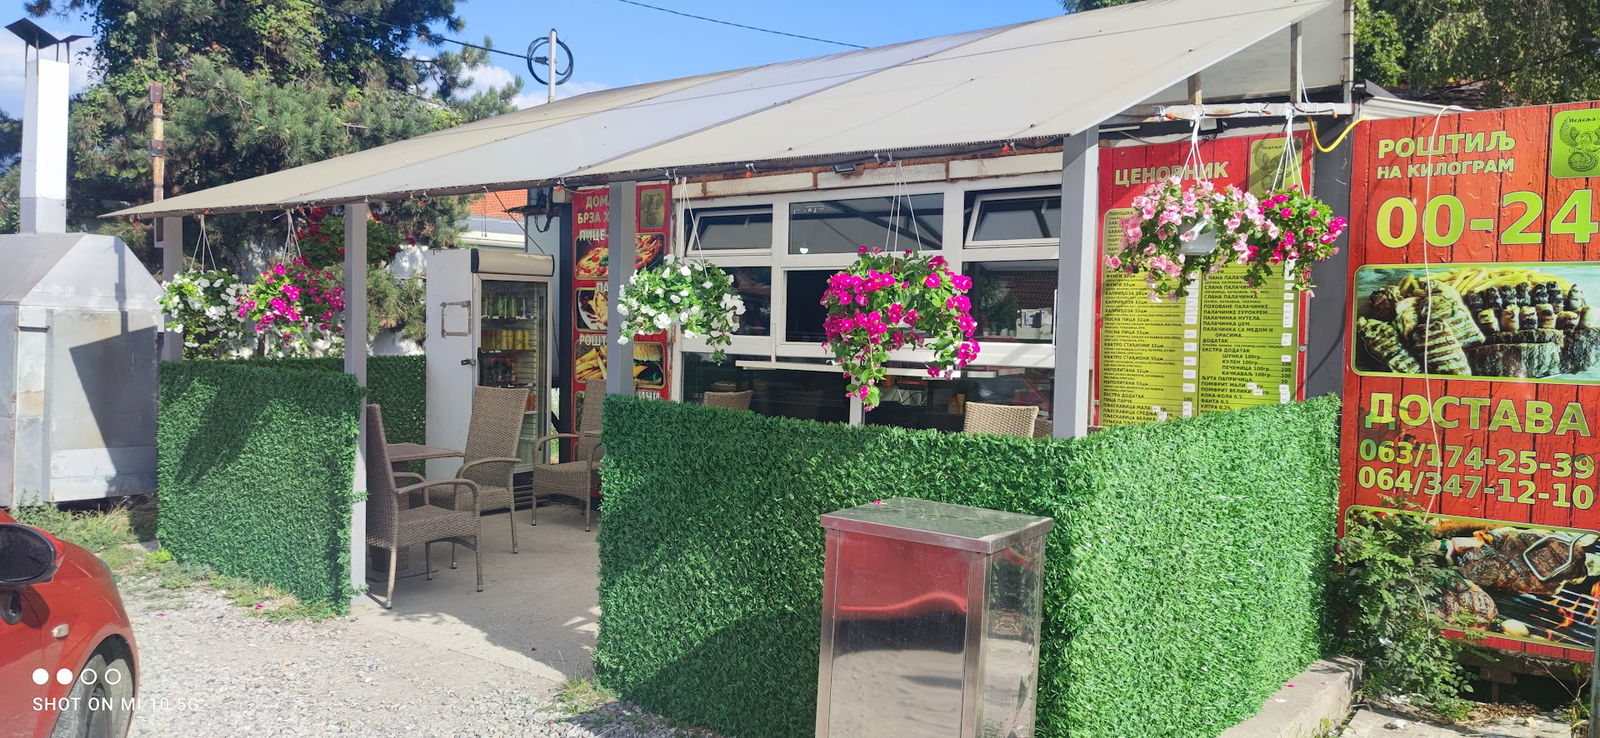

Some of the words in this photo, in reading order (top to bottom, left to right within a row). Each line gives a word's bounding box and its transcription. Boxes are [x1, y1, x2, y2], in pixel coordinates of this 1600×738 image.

[1378, 131, 1515, 159] РОШТИЉ
[1115, 161, 1229, 187] ЦЕНОВНИК
[1377, 165, 1401, 179] НА
[1408, 159, 1514, 177] КИЛОГРАМ
[586, 195, 609, 209] ДОМ
[578, 212, 601, 224] БРЗА
[1376, 189, 1599, 248] 00-24
[579, 335, 608, 346] РОШТ
[1364, 392, 1591, 437] ДОСТАВА
[1360, 439, 1595, 479] 063/174-25-39
[1358, 466, 1594, 510] 064/347-12-10
